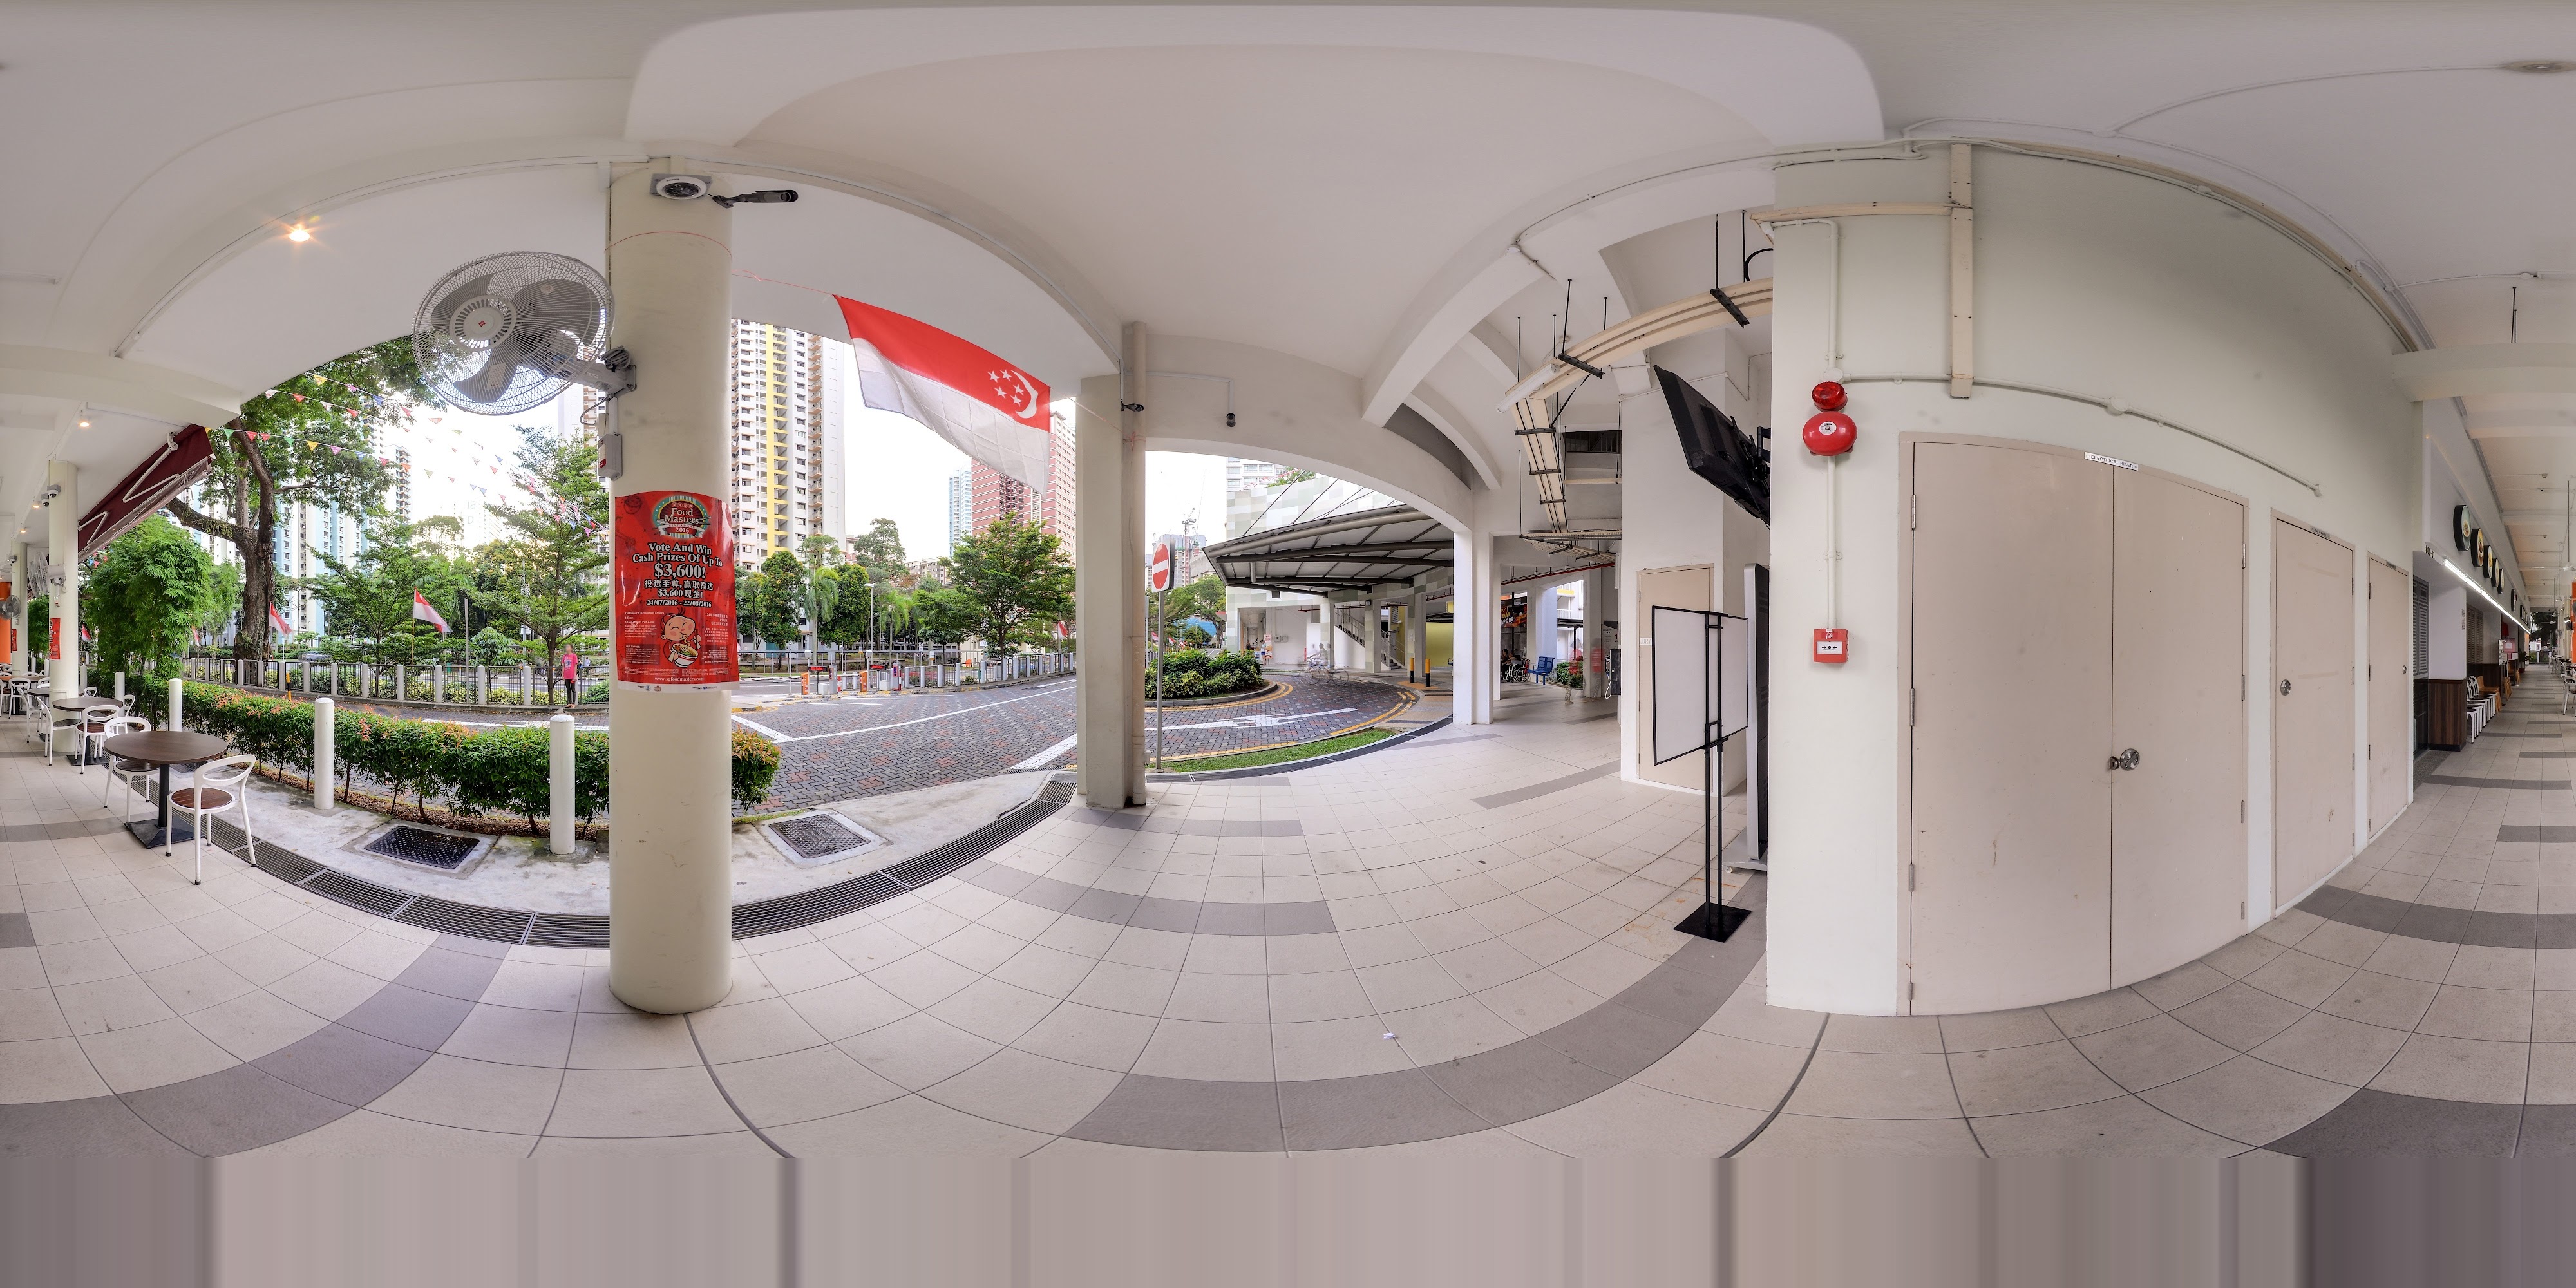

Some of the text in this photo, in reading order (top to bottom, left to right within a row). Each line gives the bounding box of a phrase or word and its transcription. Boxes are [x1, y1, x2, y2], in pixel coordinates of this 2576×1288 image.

[2090, 455, 2119, 465] ELECTRICAL
[671, 507, 693, 516] Food
[664, 515, 699, 524] Masters
[648, 542, 712, 555] Vote And Win
[632, 552, 723, 567] Cash Prizes Of Up To
[654, 562, 706, 579] $3,600!
[1501, 616, 1514, 625] APORE
